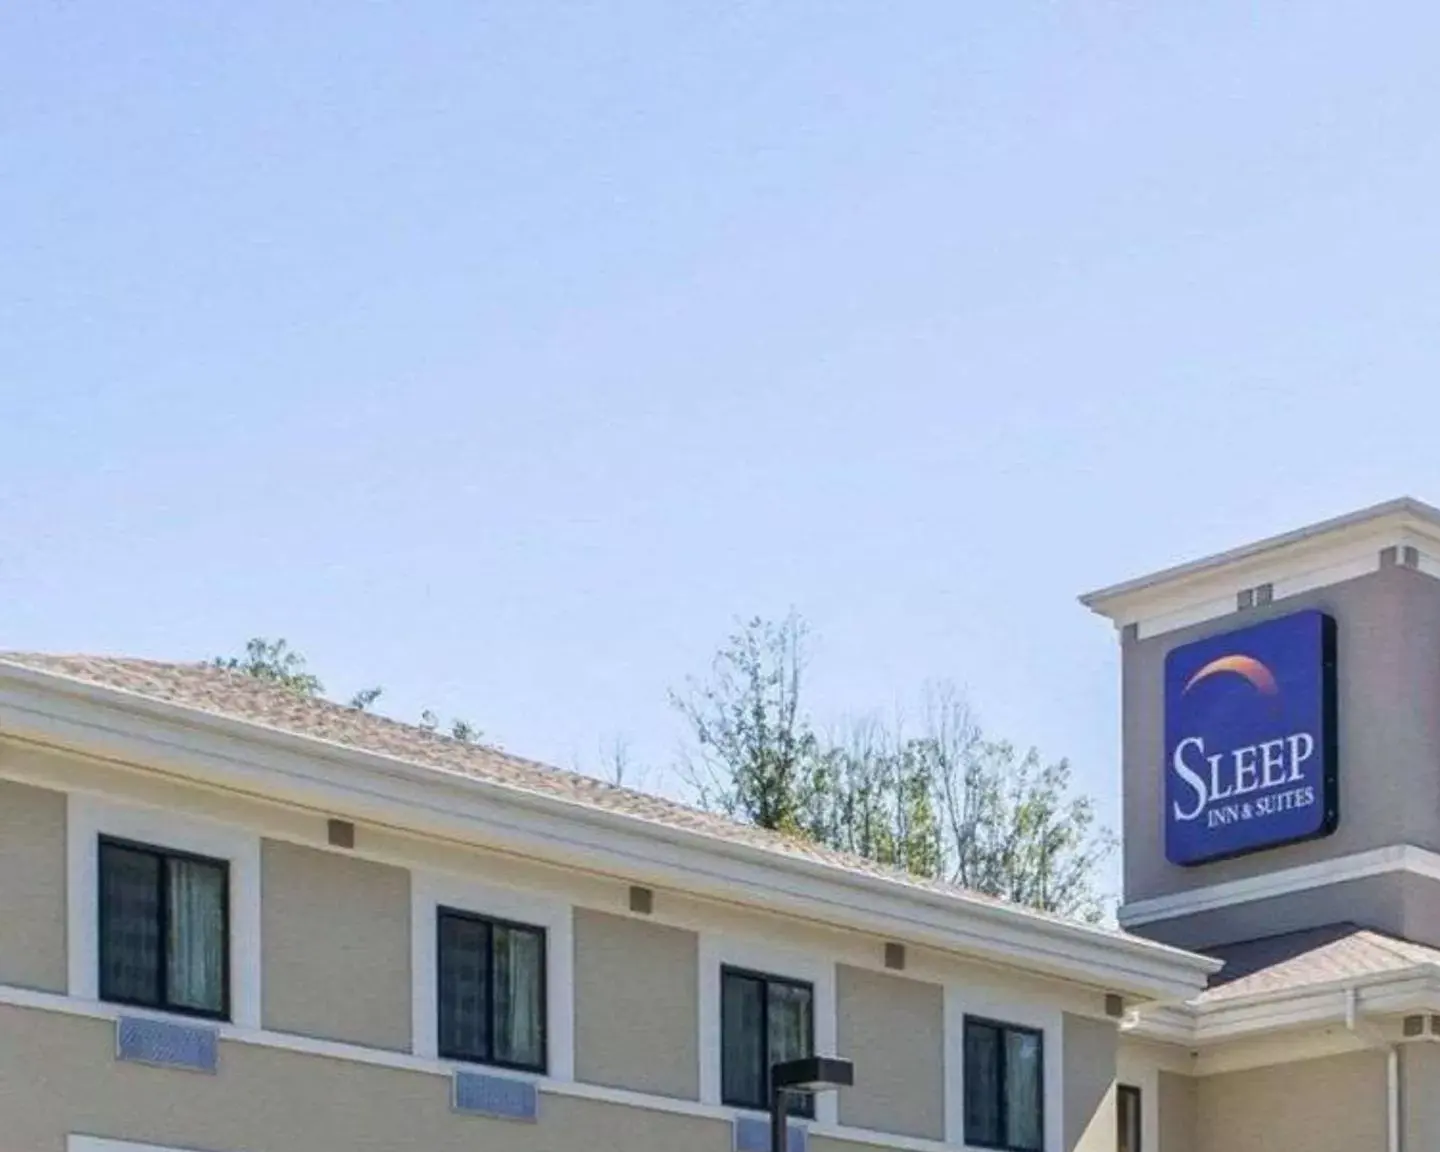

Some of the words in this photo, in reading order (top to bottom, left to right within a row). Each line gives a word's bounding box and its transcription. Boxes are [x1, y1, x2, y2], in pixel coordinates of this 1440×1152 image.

[1173, 732, 1314, 822] SLEEP
[1207, 803, 1239, 828] INN
[1256, 786, 1315, 818] SUITES
